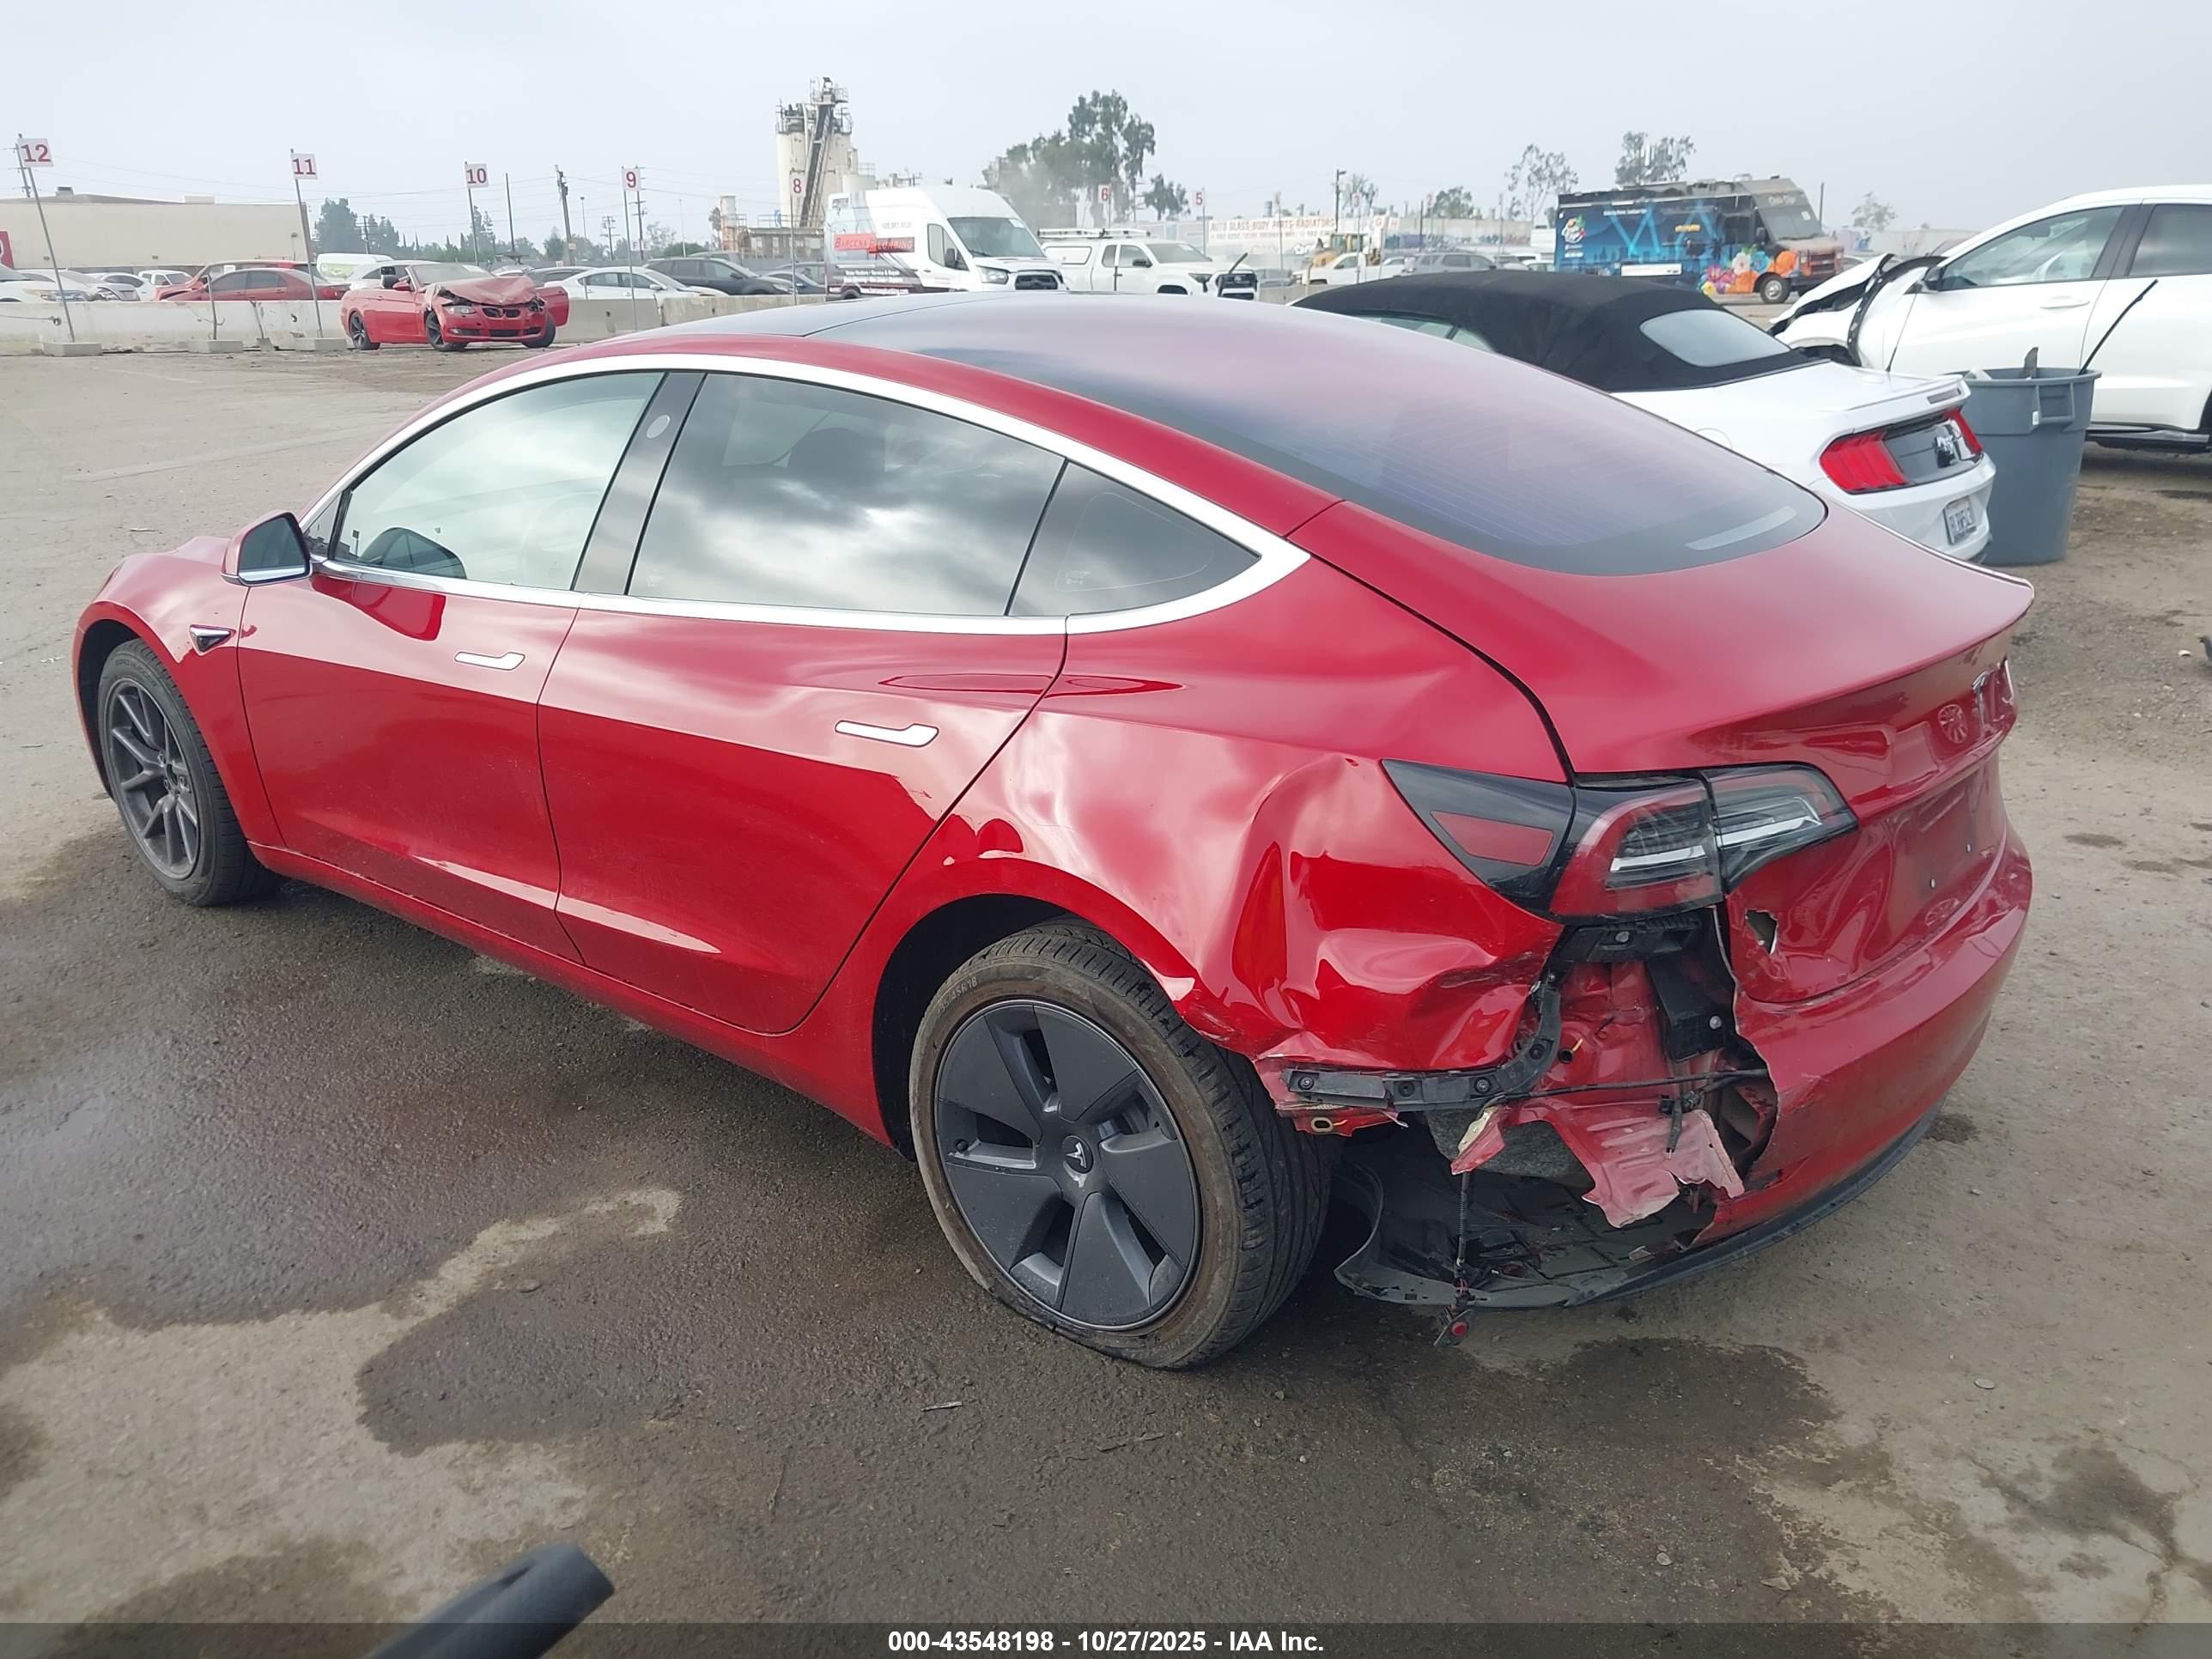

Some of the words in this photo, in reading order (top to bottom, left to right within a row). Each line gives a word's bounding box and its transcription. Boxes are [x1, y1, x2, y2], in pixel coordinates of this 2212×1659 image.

[21, 143, 52, 163] 12
[292, 158, 317, 176] 11
[466, 167, 487, 185] 10
[625, 171, 637, 188] 9
[793, 179, 802, 194] 8
[1101, 187, 1109, 202] 6
[1195, 192, 1203, 205] 5
[1210, 222, 1227, 232] AUTO
[868, 239, 913, 251] PLUMBING
